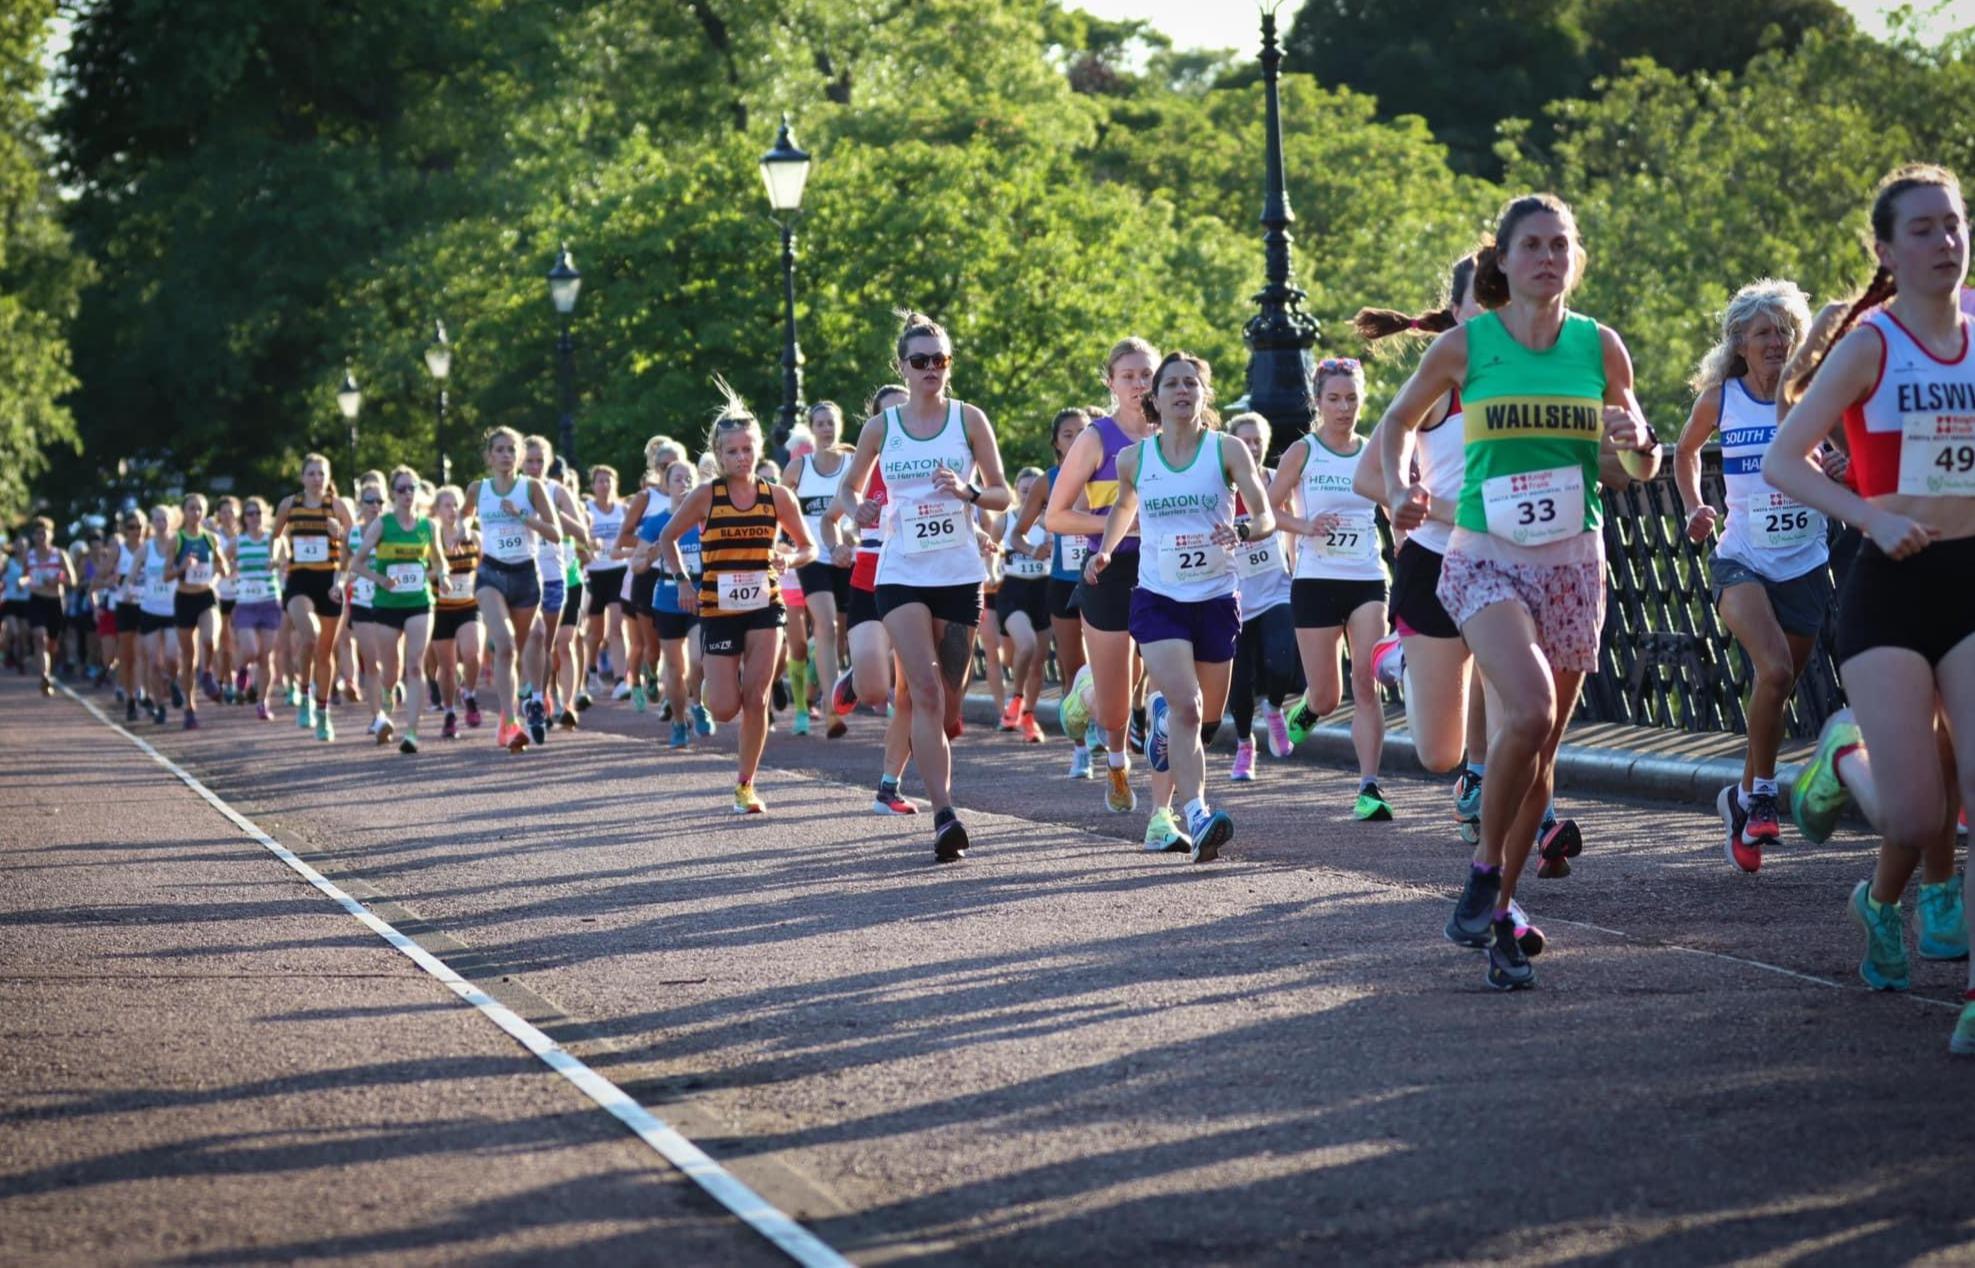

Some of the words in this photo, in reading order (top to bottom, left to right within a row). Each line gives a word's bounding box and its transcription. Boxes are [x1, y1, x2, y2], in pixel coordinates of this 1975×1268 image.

[1486, 404, 1597, 431] WALLSEND
[1726, 430, 1764, 444] SOUTH
[885, 457, 943, 473] HEATON
[1935, 446, 1975, 472] 49
[1309, 475, 1352, 485] HEATO
[1144, 495, 1199, 511] HEATON
[1518, 498, 1556, 525] 33
[915, 519, 954, 538] 296
[1766, 511, 1808, 532] 256
[720, 527, 769, 537] BLAYDON
[497, 537, 522, 549] 369
[1326, 533, 1358, 547] 277
[1179, 552, 1207, 569] 22
[1249, 550, 1268, 565] 80
[1021, 562, 1043, 573] 119
[729, 586, 760, 600] 407
